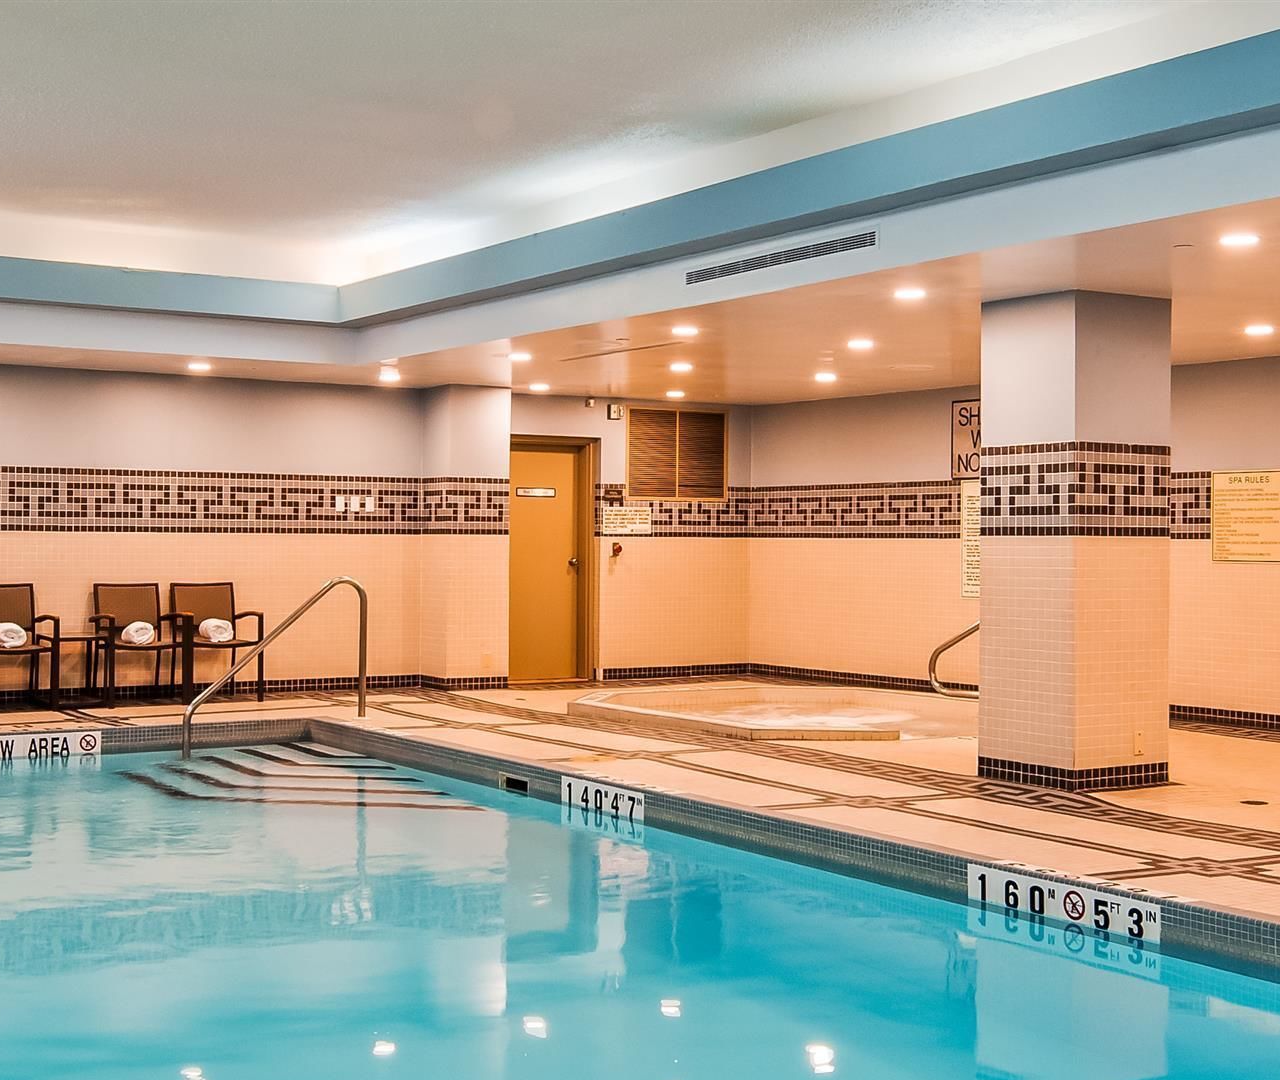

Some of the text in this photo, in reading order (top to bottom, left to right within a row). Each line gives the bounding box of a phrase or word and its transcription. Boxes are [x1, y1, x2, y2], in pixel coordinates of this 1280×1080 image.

[1228, 475, 1270, 484] SPA RULES
[28, 736, 70, 758] AREA
[1145, 910, 1157, 923] IN
